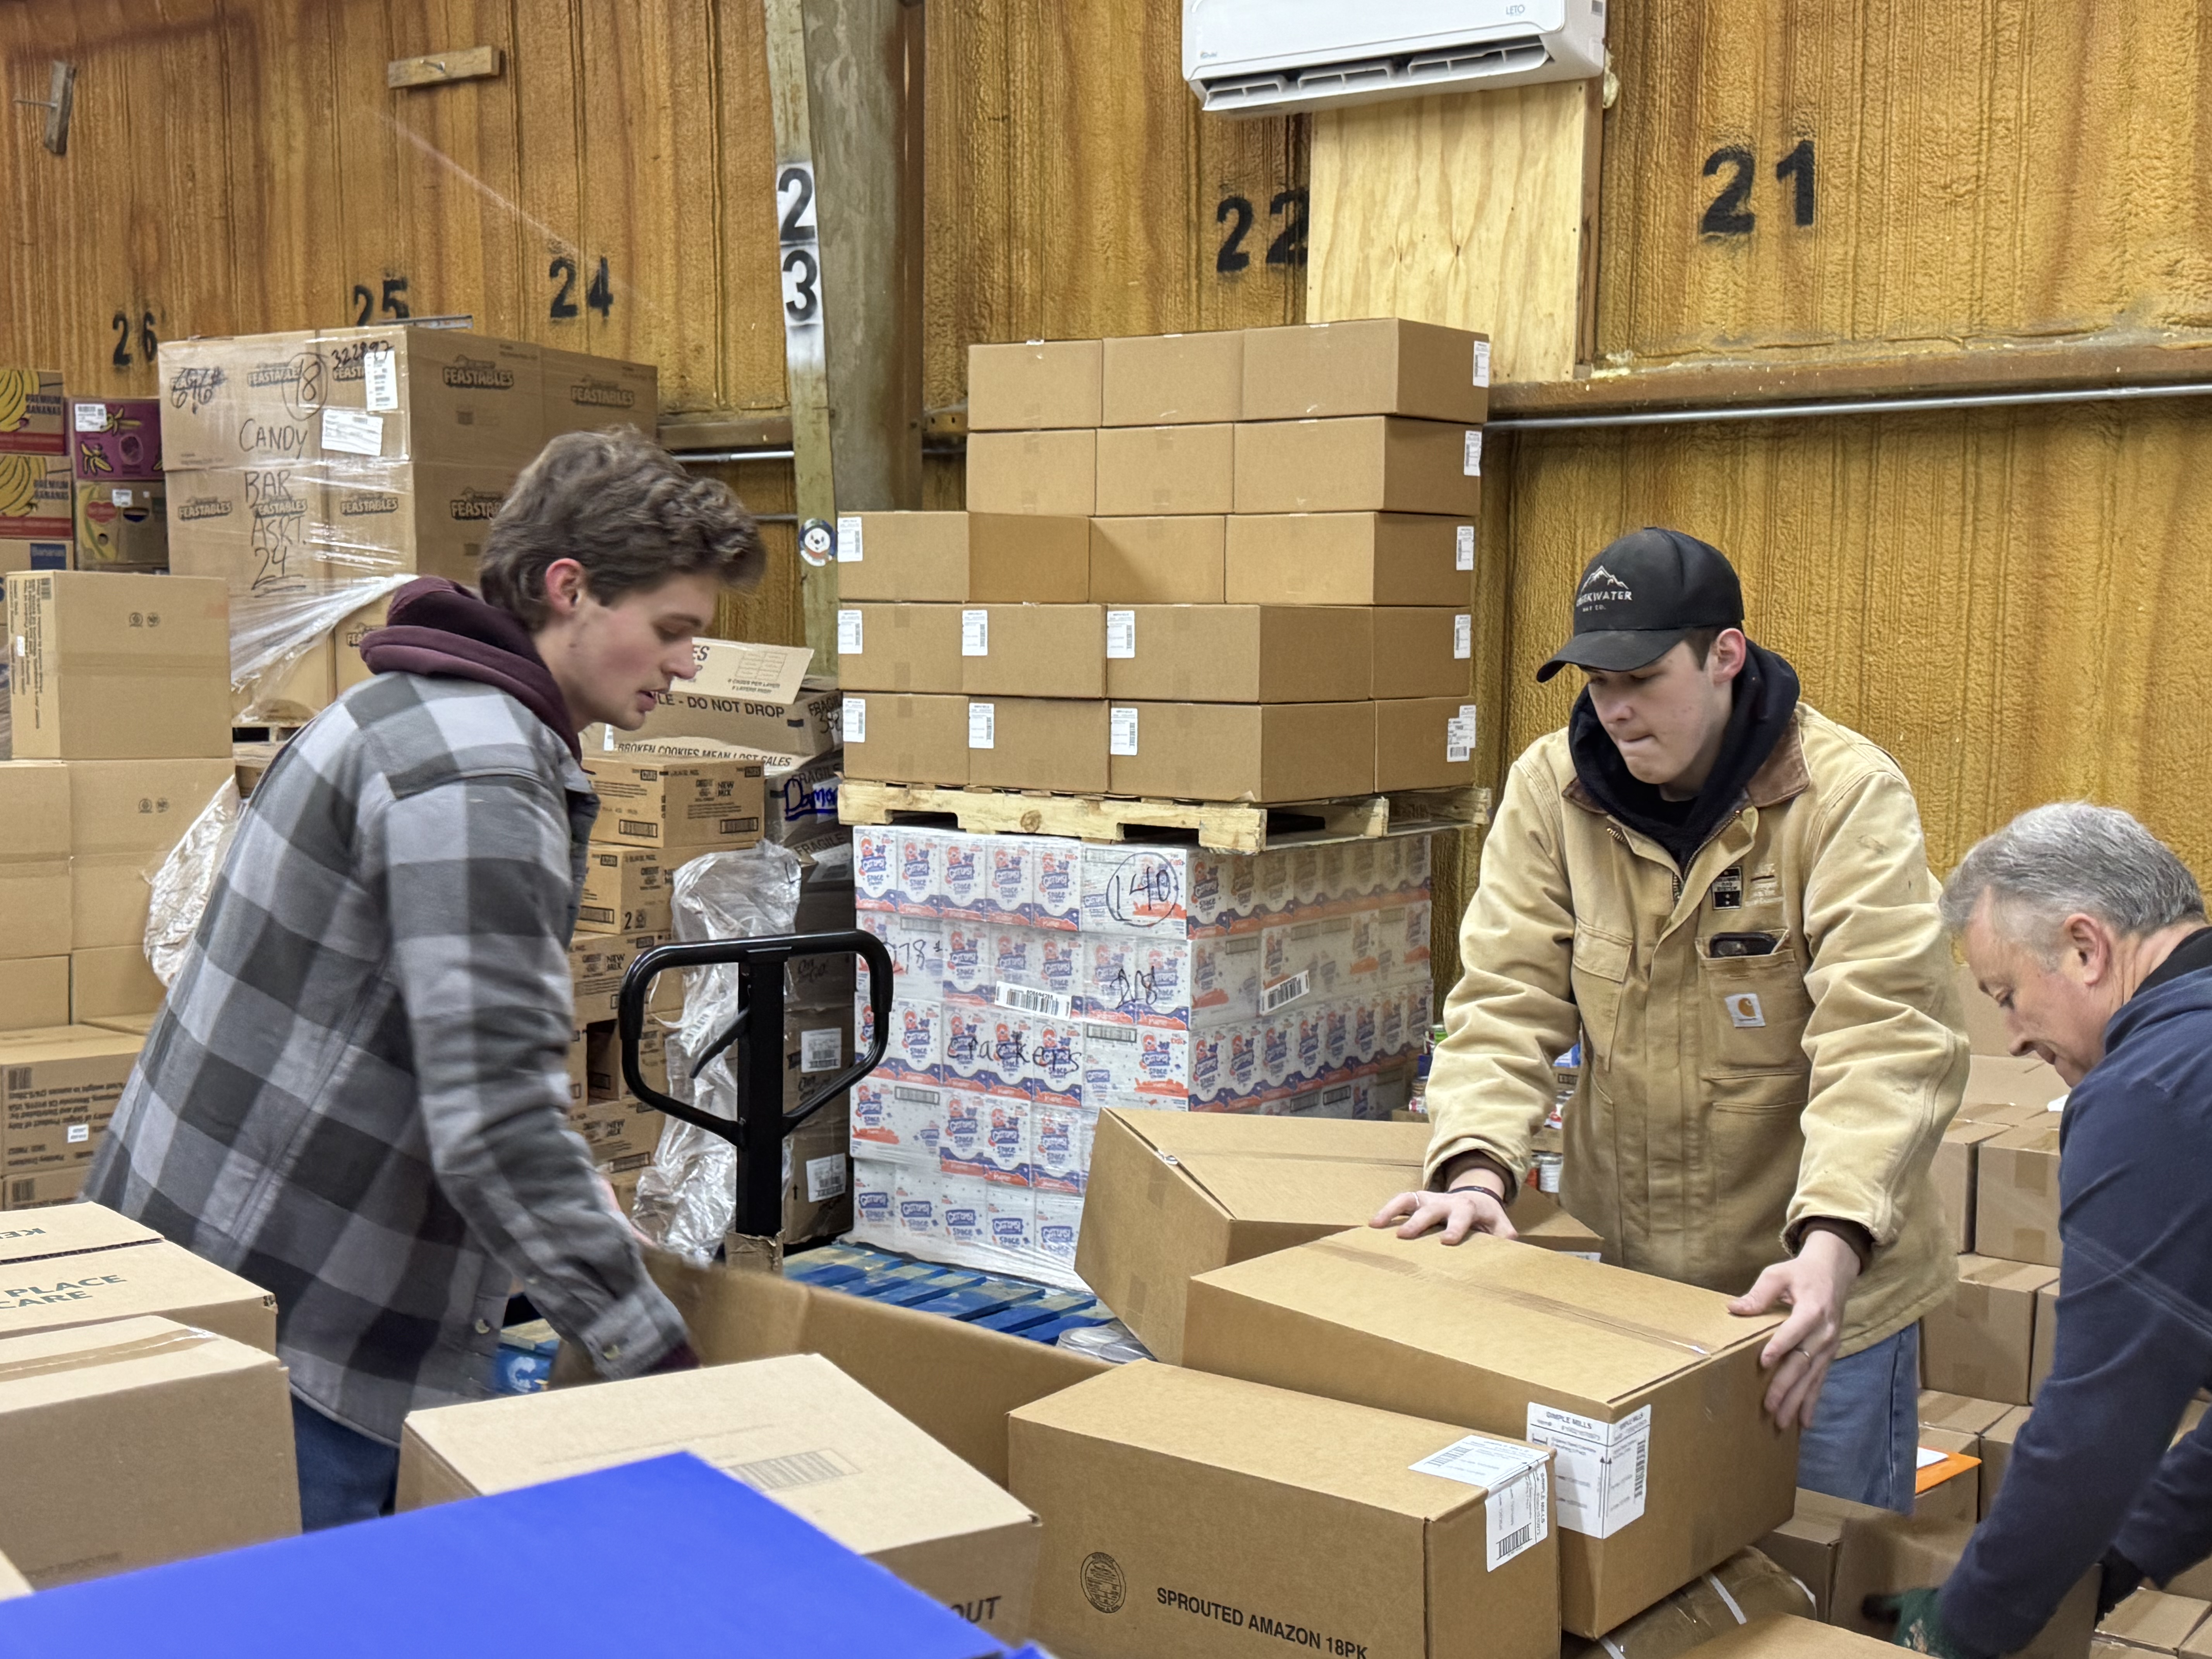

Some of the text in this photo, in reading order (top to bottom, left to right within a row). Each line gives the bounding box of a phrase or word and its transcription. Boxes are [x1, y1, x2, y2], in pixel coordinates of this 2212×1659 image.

[1506, 4, 1525, 15] LETO
[1700, 140, 1815, 233] 21
[1216, 189, 1309, 272] 22
[549, 256, 613, 318] 24
[354, 276, 410, 326] 25
[112, 311, 156, 365] 26
[297, 359, 321, 407] 18
[444, 368, 514, 387] FEASTABLES
[572, 388, 634, 405] FEASTABLES
[240, 418, 308, 460] CANDY
[245, 470, 293, 509] BAR
[179, 503, 231, 519] FEASTABLES
[341, 499, 398, 514] FEASTABLES
[688, 696, 708, 709] DO
[712, 699, 739, 713] NOT
[746, 703, 785, 718] DROP
[761, 756, 792, 766] SALES
[794, 833, 847, 855] FRAGILE
[1116, 867, 1171, 911] 140
[624, 912, 632, 930] 2
[607, 954, 625, 962] NEW
[0, 1228, 46, 1239] KE
[4, 1275, 127, 1297] PLACE
[1157, 1587, 1368, 1659] SPROUTED AMAZON 18PK
